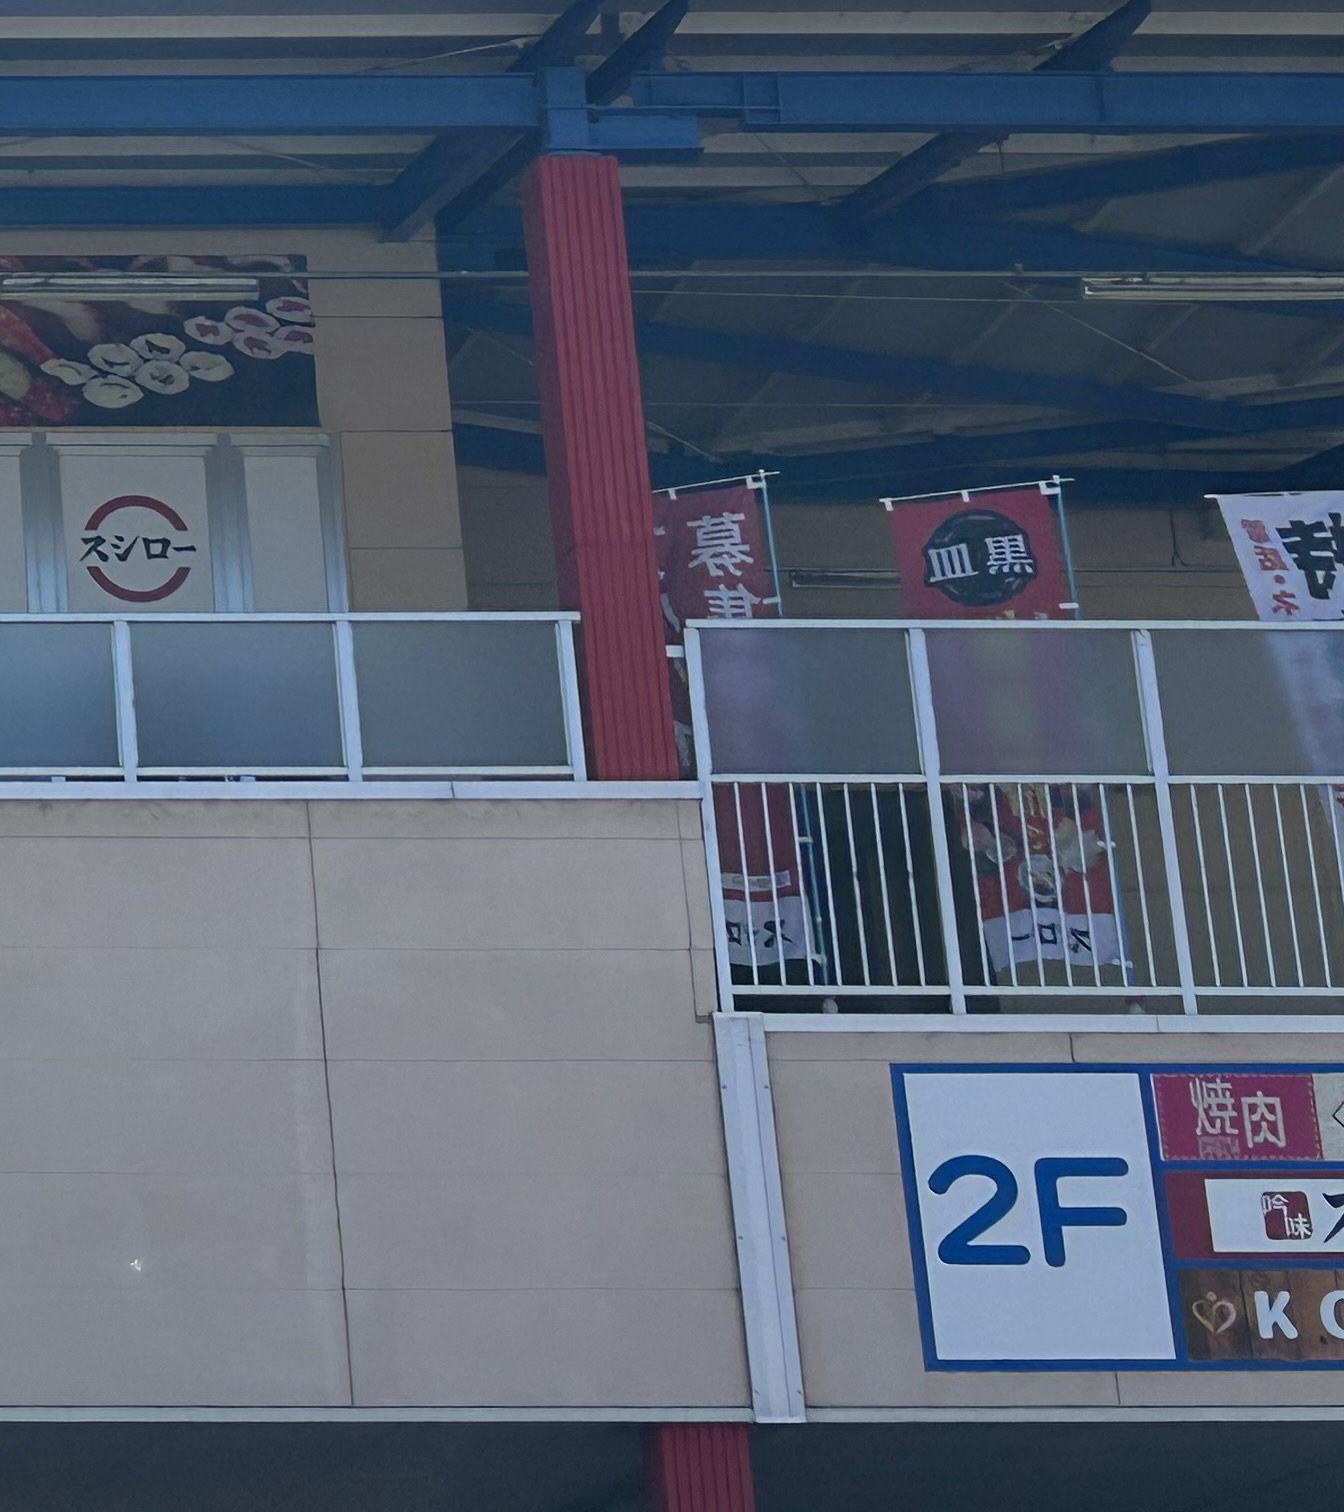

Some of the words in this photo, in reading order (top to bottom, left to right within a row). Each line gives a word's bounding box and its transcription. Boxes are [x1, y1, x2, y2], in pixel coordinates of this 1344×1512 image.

[79, 535, 197, 563] スシロー
[1189, 1077, 1287, 1149] 焼肉
[927, 1154, 1130, 1268] 2F
[1262, 1193, 1312, 1240] 吟味
